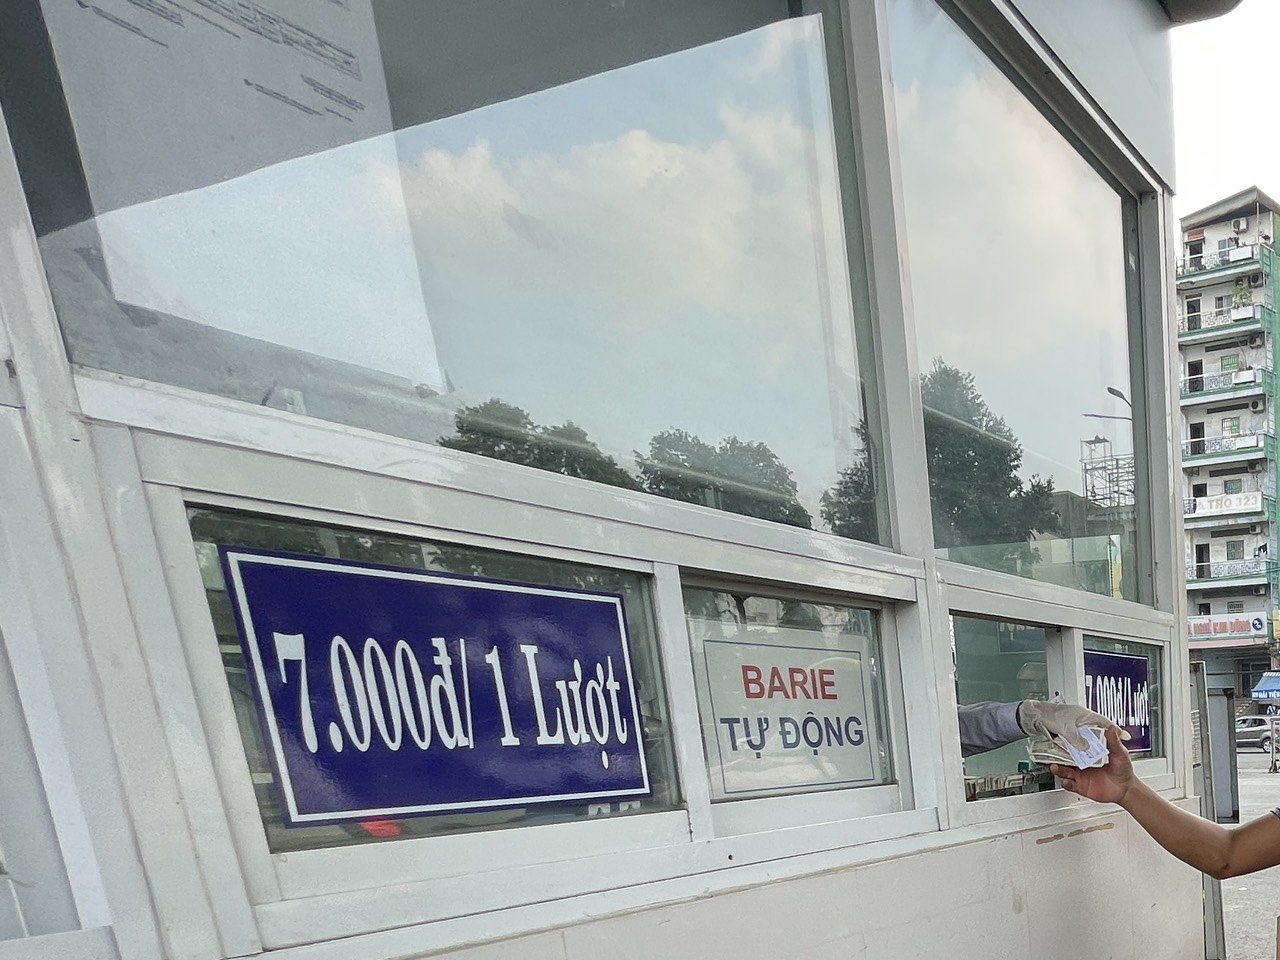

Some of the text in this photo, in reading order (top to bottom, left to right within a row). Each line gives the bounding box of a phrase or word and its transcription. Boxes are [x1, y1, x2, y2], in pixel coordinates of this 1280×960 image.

[272, 631, 628, 769] 7.000đ/ 1 Lượt
[741, 665, 838, 700] BARIE
[720, 711, 865, 759] TỰ ĐỘNG
